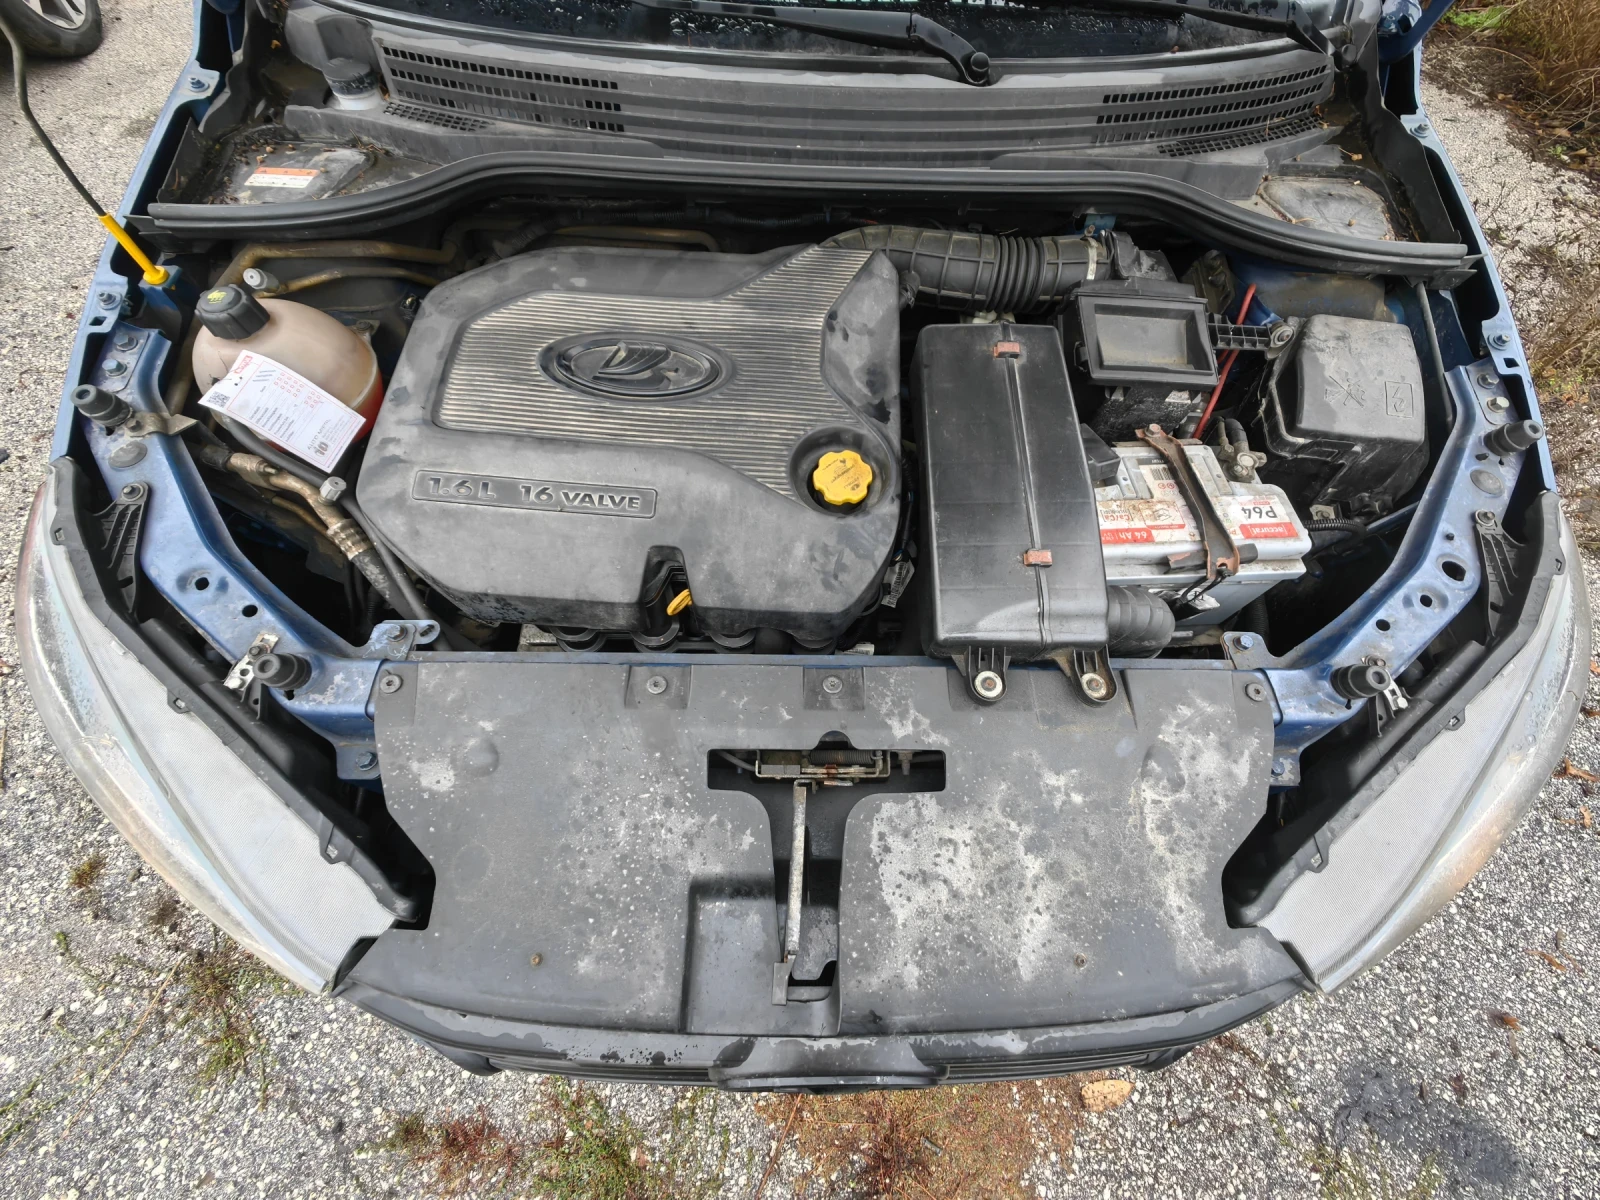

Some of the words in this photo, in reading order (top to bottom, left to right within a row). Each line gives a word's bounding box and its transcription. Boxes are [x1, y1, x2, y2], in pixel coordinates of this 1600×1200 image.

[520, 484, 555, 504] 16
[561, 490, 642, 511] VALVE
[1241, 505, 1278, 520] P64
[1119, 531, 1132, 539] Ah
[1134, 531, 1148, 539] 64
